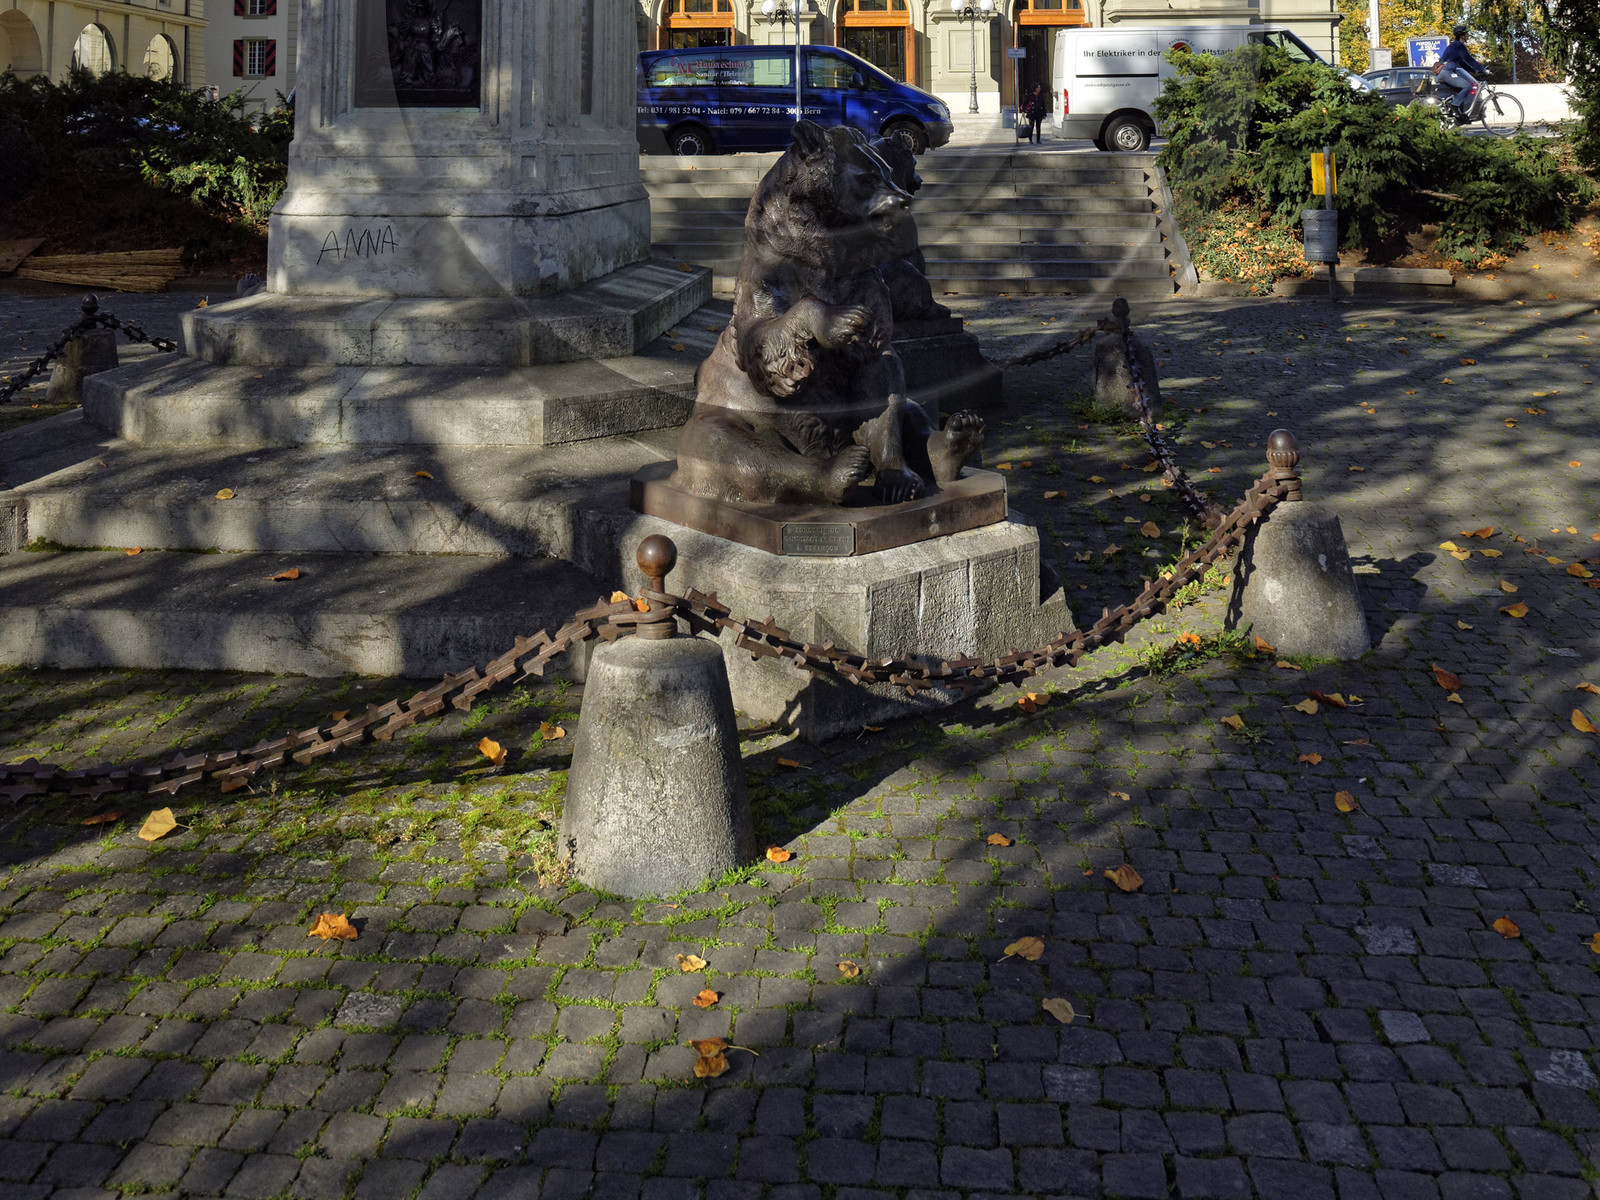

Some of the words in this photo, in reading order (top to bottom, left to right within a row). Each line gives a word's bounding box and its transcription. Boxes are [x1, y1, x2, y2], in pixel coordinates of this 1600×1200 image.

[637, 106, 649, 114] Tel:
[707, 107, 728, 115] Natel:
[316, 225, 399, 265] ANNA
